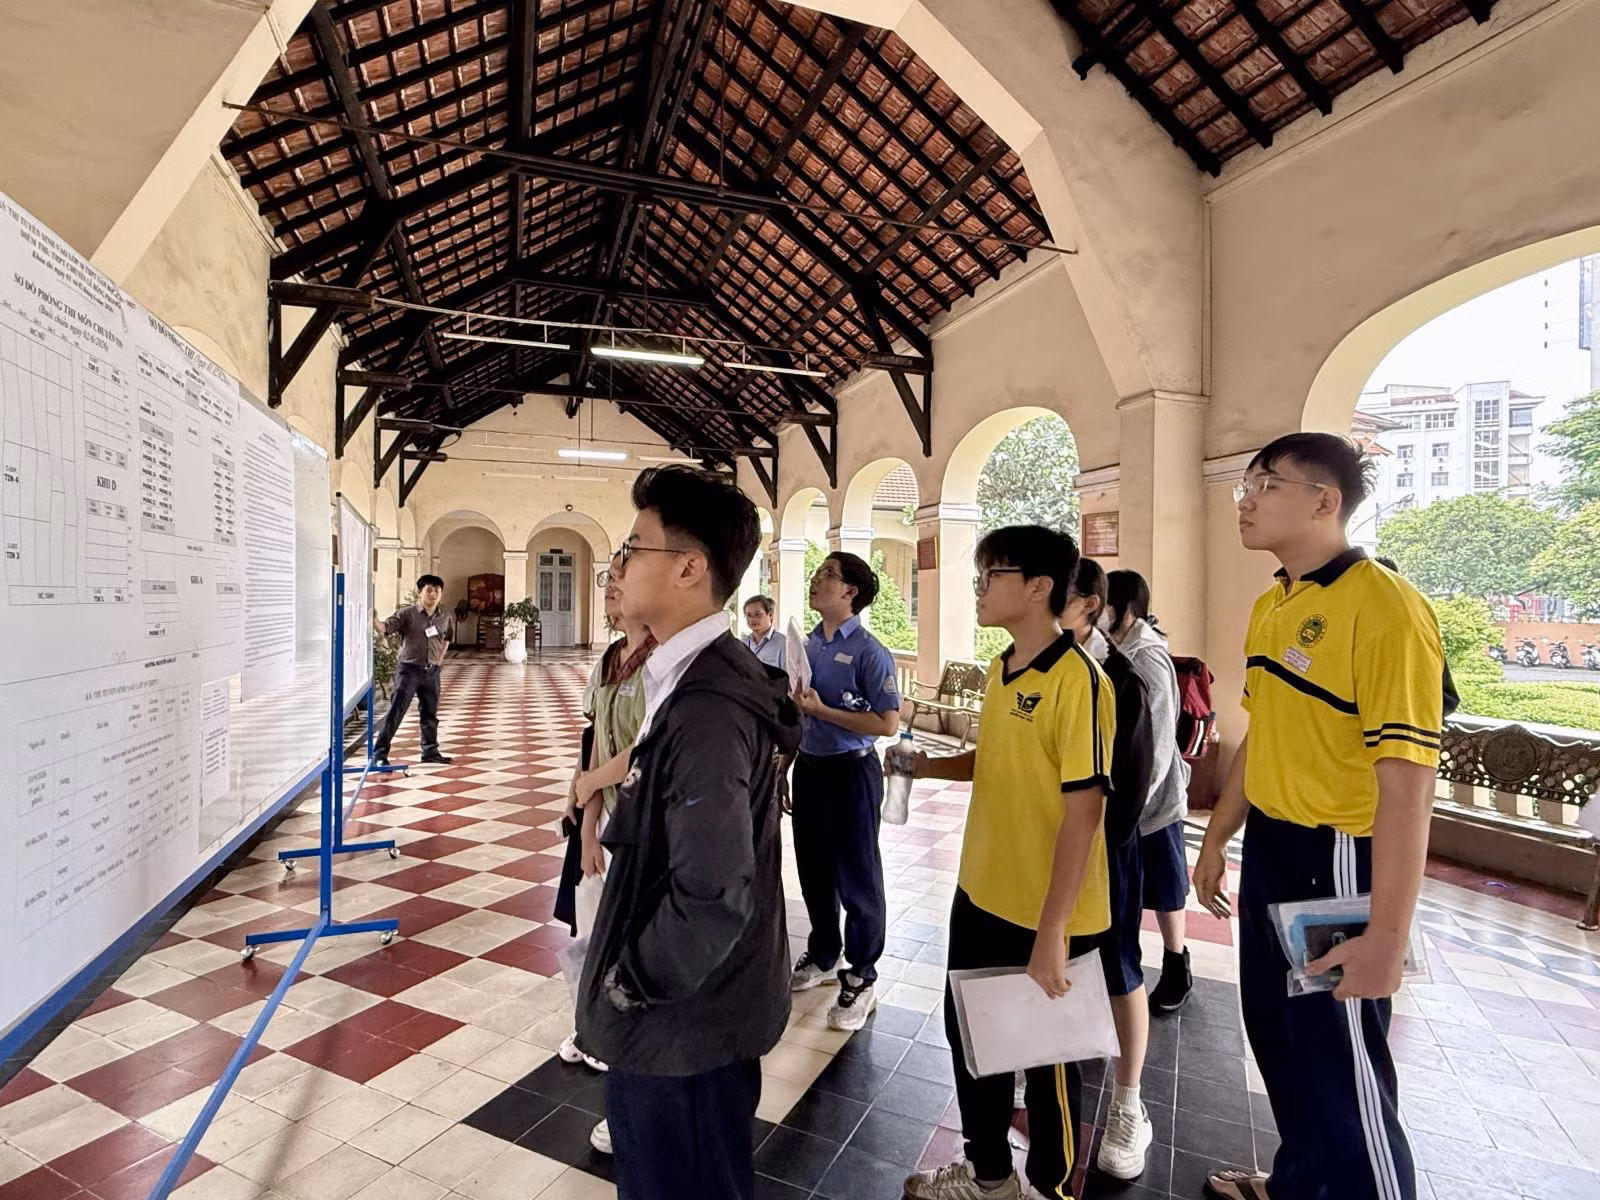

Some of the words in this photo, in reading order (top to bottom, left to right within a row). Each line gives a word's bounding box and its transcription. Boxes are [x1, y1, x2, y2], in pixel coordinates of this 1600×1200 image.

[38, 287, 63, 312] PHÒNG
[63, 303, 77, 319] THI
[96, 475, 111, 490] KHU
[111, 479, 117, 491] D
